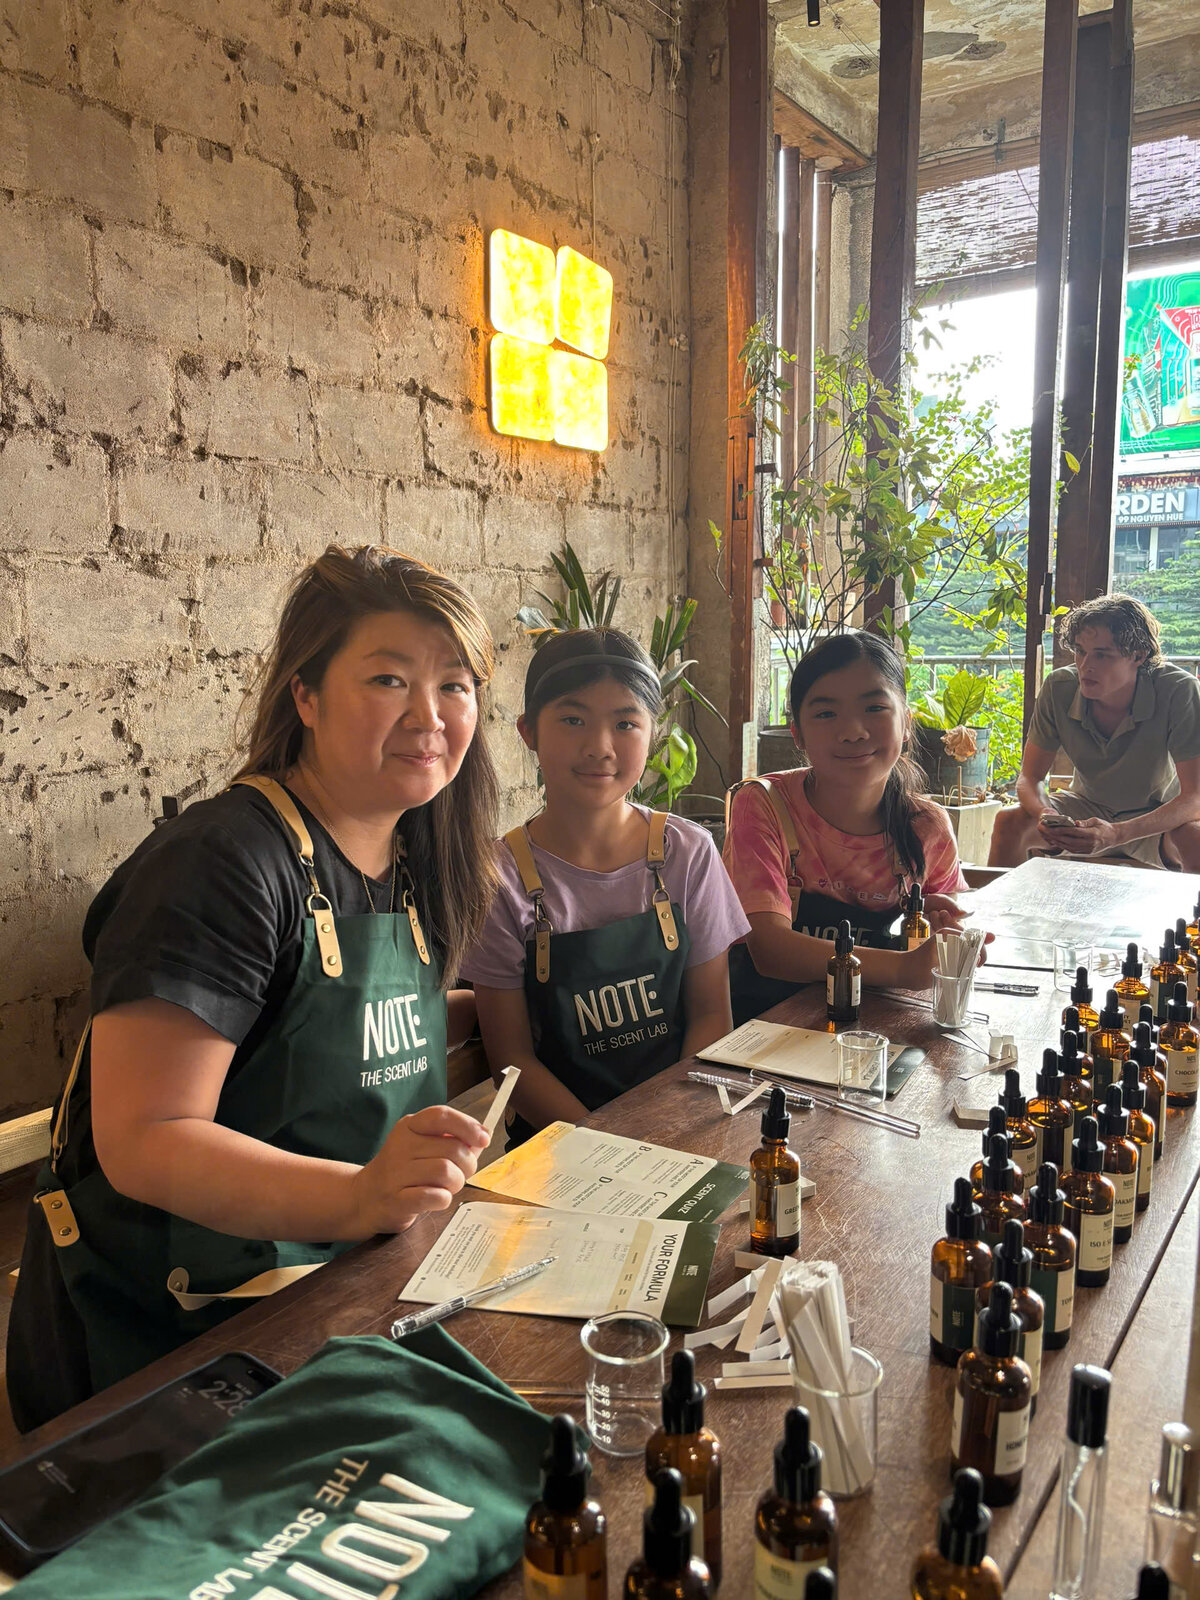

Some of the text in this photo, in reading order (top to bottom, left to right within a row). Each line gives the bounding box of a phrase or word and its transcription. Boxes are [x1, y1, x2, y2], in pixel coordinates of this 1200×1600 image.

[1118, 513, 1184, 523] 99 NGUYEN HUE
[574, 973, 664, 1036] NOTE
[363, 993, 427, 1061] NOTE
[584, 1022, 669, 1055] THE SCENT LAB
[360, 1056, 428, 1087] THE SCENT LAB
[688, 1157, 706, 1166] A
[595, 1175, 614, 1184] D
[651, 1190, 670, 1199] C
[674, 1181, 717, 1214] SCENT QUIZ
[658, 1233, 678, 1257] YOUR
[643, 1258, 671, 1302] FORMULA
[314, 1457, 370, 1508] THE
[243, 1507, 327, 1573] SCENT
